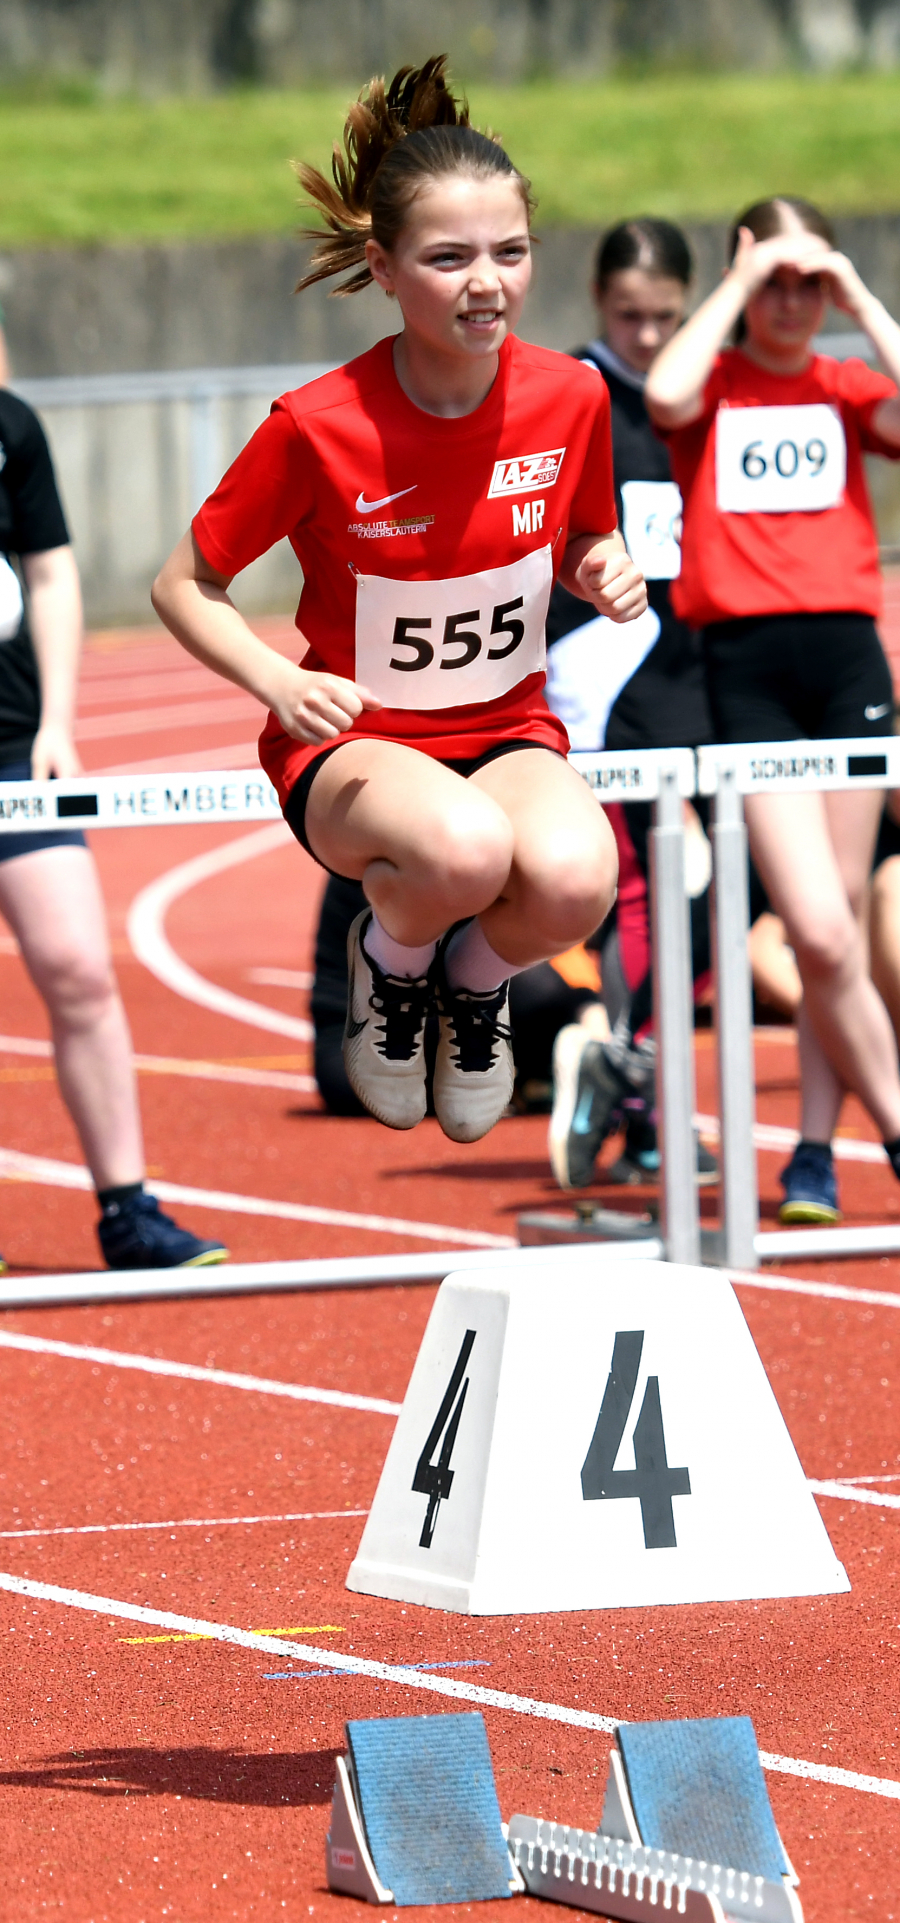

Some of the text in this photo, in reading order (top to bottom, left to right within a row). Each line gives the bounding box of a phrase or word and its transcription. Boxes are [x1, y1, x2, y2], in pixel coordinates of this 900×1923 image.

[740, 438, 828, 481] 609
[347, 514, 436, 533] ABSOLUTE TEAMSPORT
[357, 523, 428, 539] KAISERSLAUTERN
[511, 498, 546, 537] MR
[389, 595, 526, 673] 555
[411, 1329, 477, 1549] 4
[580, 1330, 692, 1549] 4
